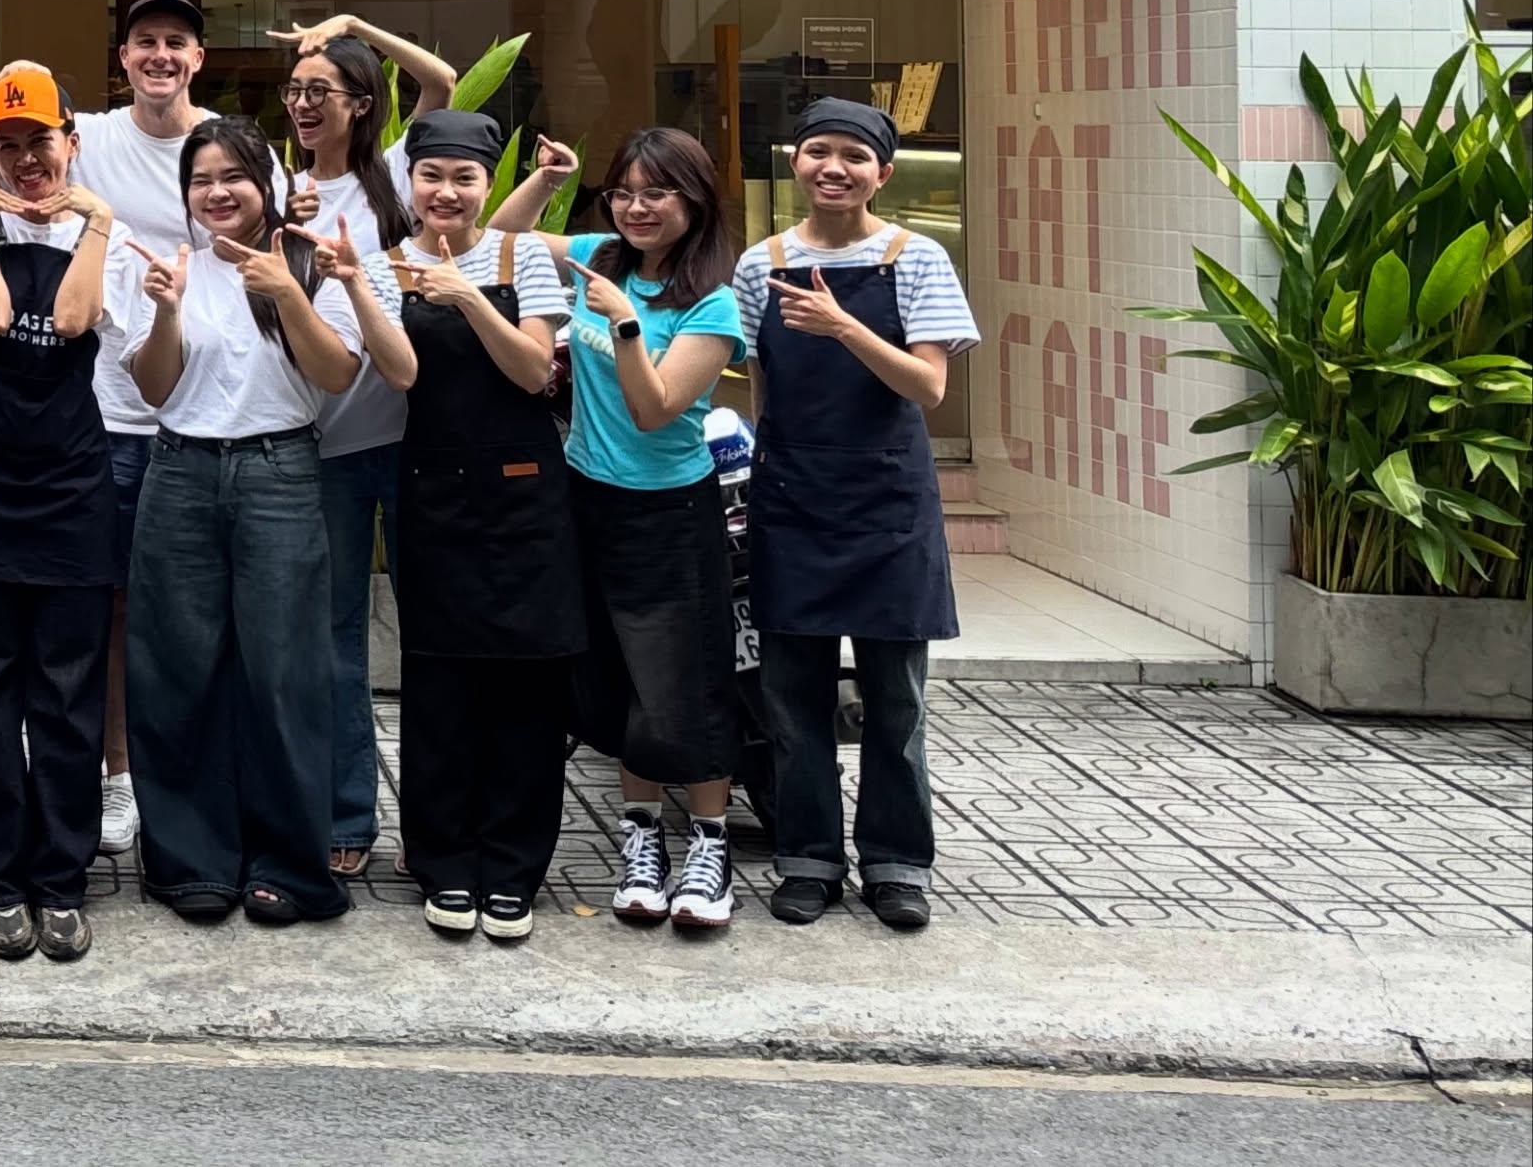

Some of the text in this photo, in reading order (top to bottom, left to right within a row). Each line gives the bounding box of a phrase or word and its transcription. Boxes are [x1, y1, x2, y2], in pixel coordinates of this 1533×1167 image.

[4, 81, 26, 109] LA
[997, 124, 1111, 294] EAT
[9, 308, 55, 333] AGE
[999, 312, 1171, 518] CAKE
